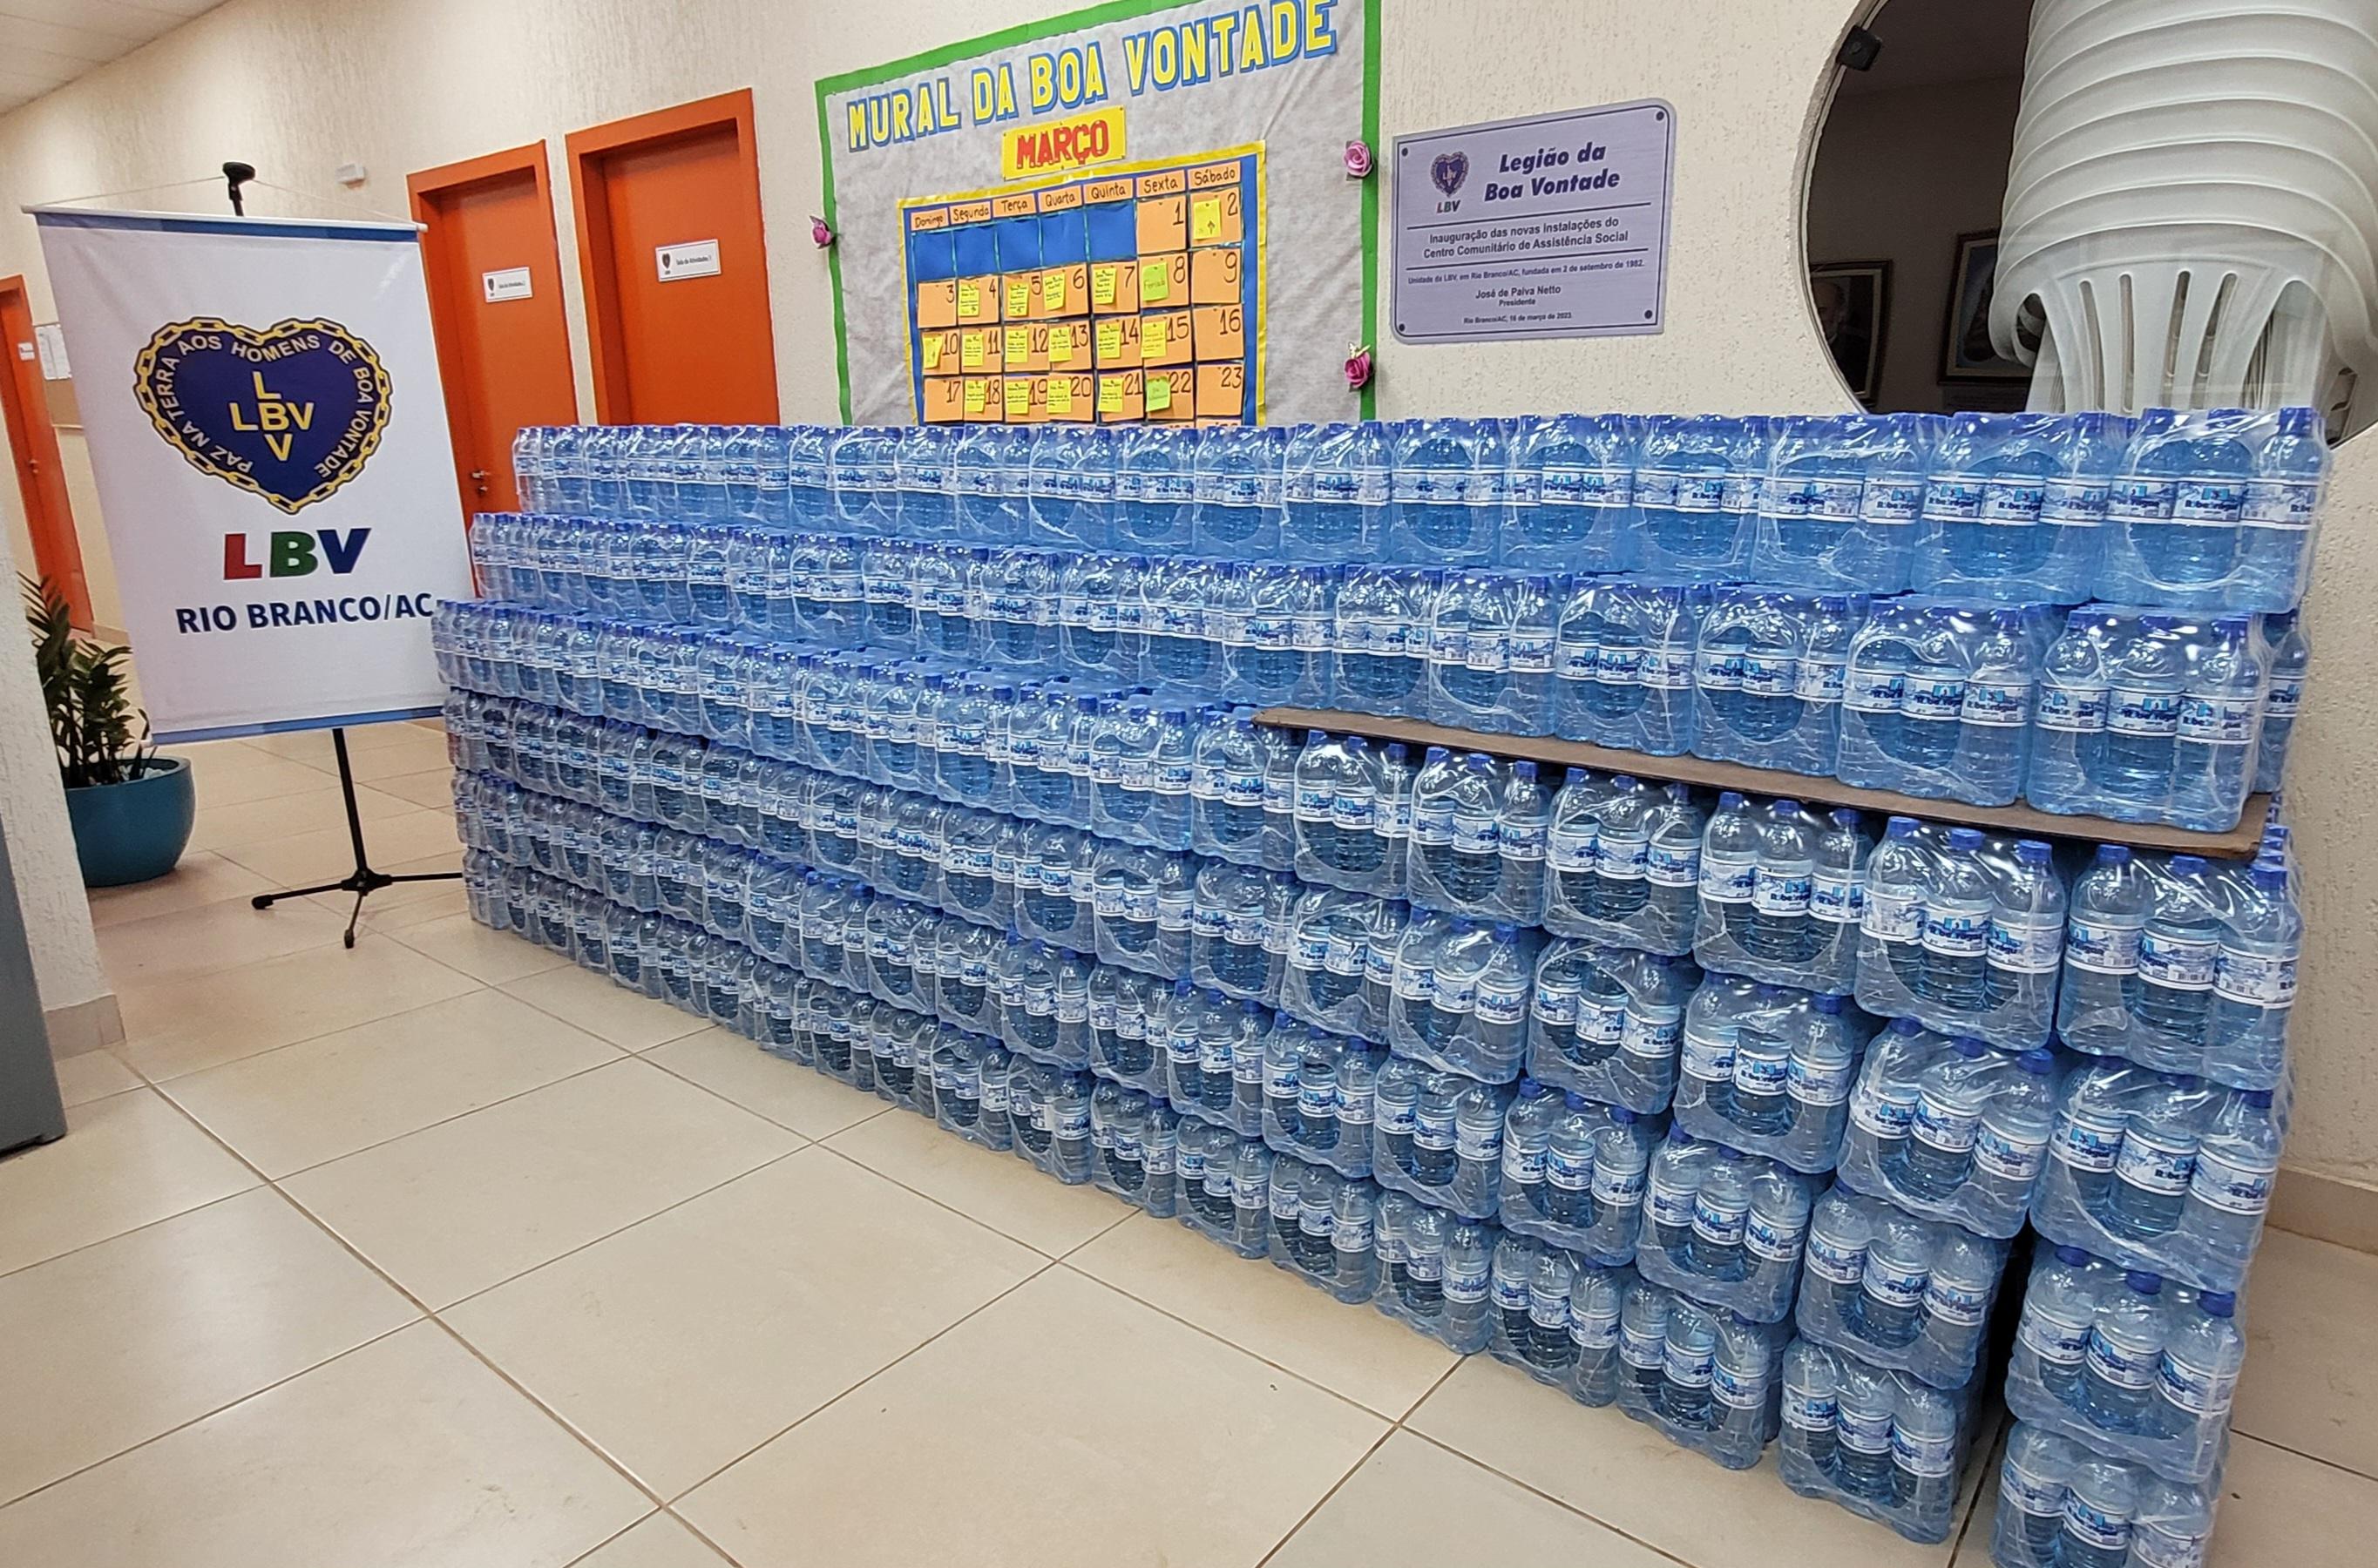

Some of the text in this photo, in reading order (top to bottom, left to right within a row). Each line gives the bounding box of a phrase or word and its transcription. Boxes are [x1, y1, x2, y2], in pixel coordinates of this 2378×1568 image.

[847, 0, 1338, 152] MURAL DA BOA VONTADE
[1017, 119, 1109, 168] MARÇO
[1499, 142, 1606, 175] Legião da
[953, 206, 989, 222] Segunda
[1001, 199, 1027, 212] Terça
[1046, 192, 1075, 206] Quarta
[1091, 185, 1126, 199] Quinta
[1144, 177, 1178, 193] Sexta
[1195, 168, 1235, 186] Sábado
[1484, 168, 1621, 201] Boa Vontade
[1173, 201, 1184, 226] 1
[1227, 193, 1238, 215] 2
[1437, 199, 1461, 213] LBV
[1430, 217, 1619, 245] Inauguração das novas instalações do
[1424, 230, 1629, 259] Centro Comunitário de Assistência Social
[1124, 266, 1135, 288] 7
[1174, 256, 1186, 283] 8
[1223, 252, 1237, 283] 9
[1579, 261, 1613, 271] setembro
[1614, 260, 1624, 269] de
[989, 279, 996, 298] 4
[1031, 276, 1041, 295] 5
[1073, 268, 1085, 289] 6
[946, 285, 954, 303] 3
[1475, 285, 1561, 299] José de Paiva Netto
[1499, 298, 1536, 307] Presidente
[1121, 319, 1139, 345] 14
[1167, 316, 1189, 342] 15
[1220, 309, 1241, 335] 16
[942, 333, 959, 355] 10
[987, 331, 1000, 355] 11
[1032, 328, 1048, 353] 12
[1071, 325, 1088, 348] 13
[1071, 376, 1091, 397] 20
[1124, 373, 1142, 395] 21
[1170, 371, 1191, 394] 22
[1221, 367, 1242, 389] 23
[946, 381, 961, 402] 17
[986, 380, 1000, 404] 18
[1029, 379, 1047, 405] 19
[155, 335, 374, 477] PAZ NA TERRA AOS HOMENS DE BOA VONTADE
[229, 402, 315, 431] LBV
[223, 528, 371, 580] LBV
[175, 593, 434, 633] RIO BRANCO/AC
